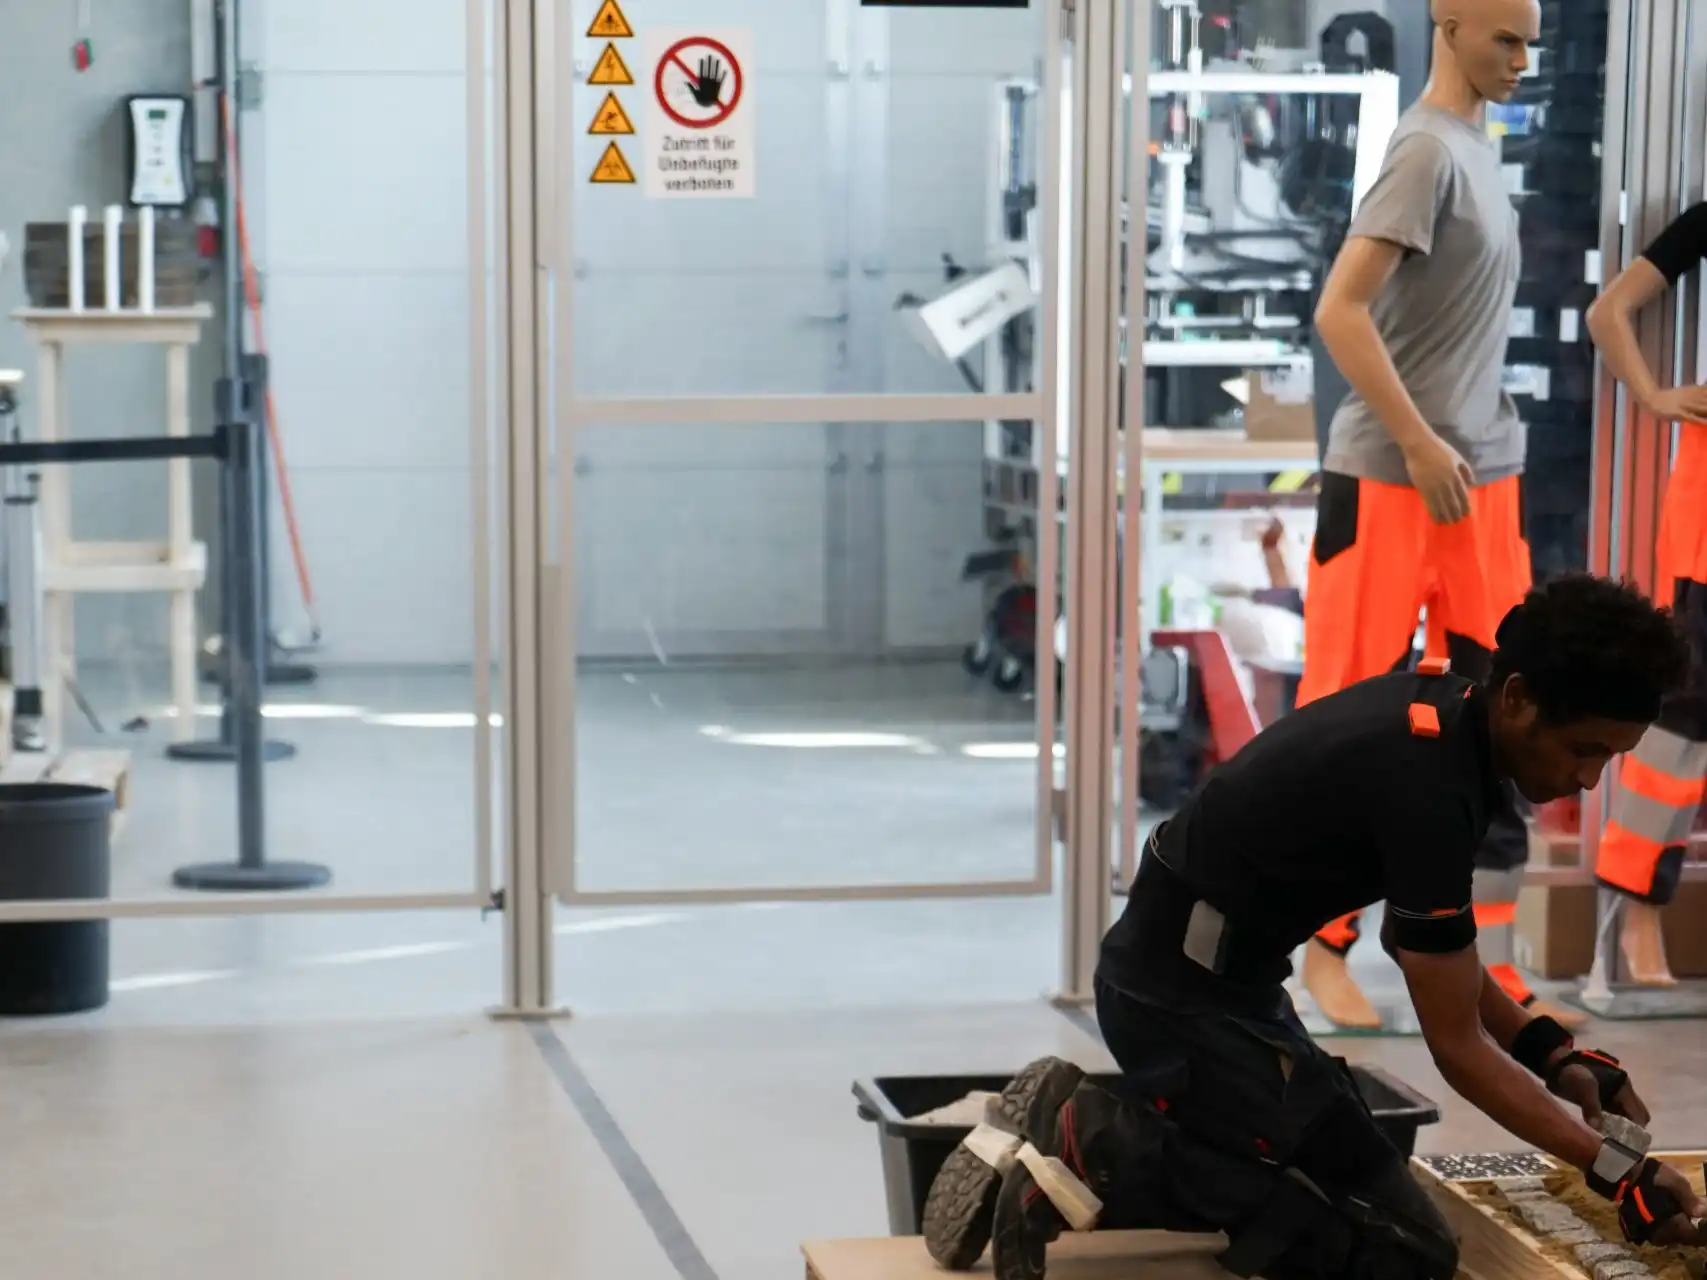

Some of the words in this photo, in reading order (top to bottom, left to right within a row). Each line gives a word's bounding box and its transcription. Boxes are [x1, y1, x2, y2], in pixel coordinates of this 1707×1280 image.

[662, 135, 710, 151] Zutritt
[713, 134, 736, 151] für
[658, 155, 739, 174] Unbefugte
[664, 176, 734, 191] verboten
